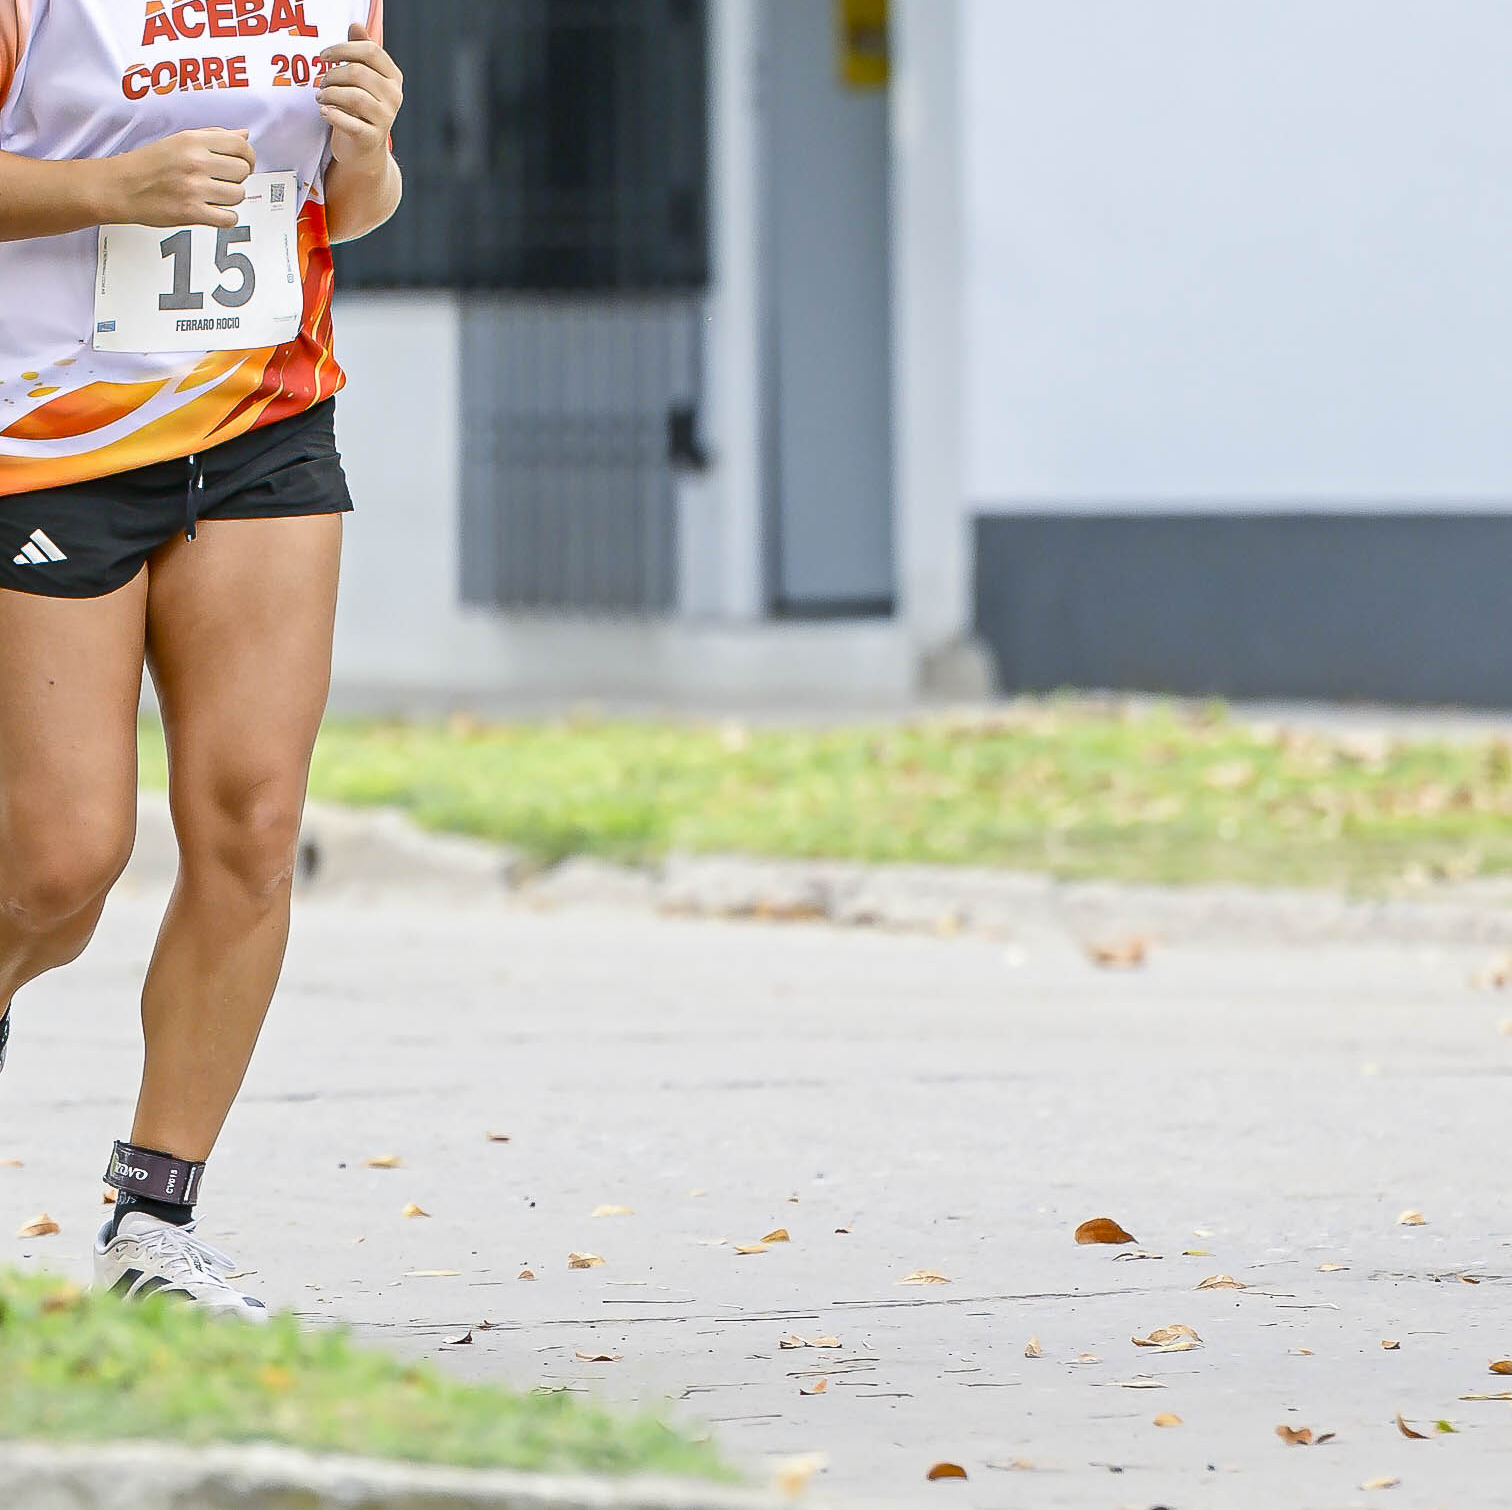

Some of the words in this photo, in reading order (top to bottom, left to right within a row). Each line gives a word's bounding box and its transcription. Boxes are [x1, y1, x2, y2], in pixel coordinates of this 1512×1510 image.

[122, 54, 250, 101] CORRE
[271, 53, 340, 89] 202
[158, 225, 256, 311] 15
[175, 319, 215, 332] FERRARO
[216, 316, 240, 330] ROCIO
